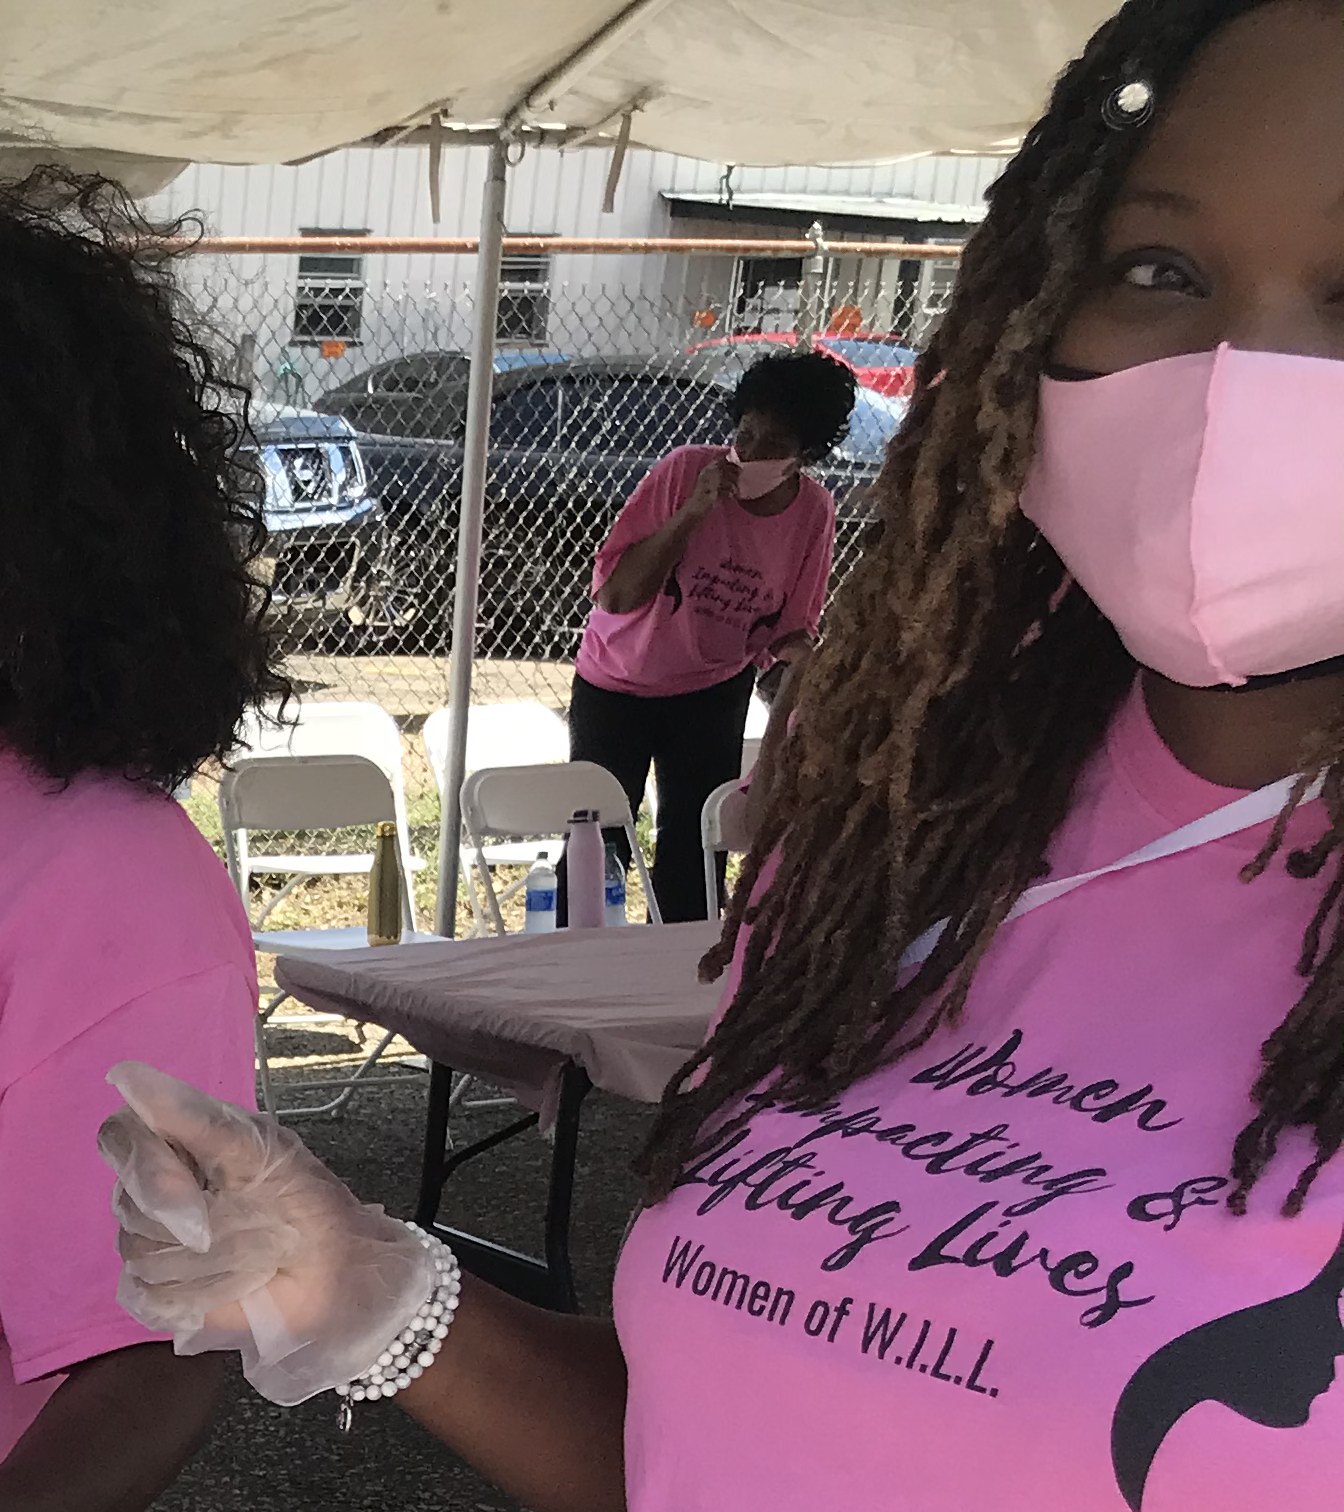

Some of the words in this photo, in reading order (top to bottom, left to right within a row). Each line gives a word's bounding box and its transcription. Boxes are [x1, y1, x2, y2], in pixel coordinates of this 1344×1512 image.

[909, 1028, 1184, 1132] Women
[674, 1127, 911, 1272] Lifting
[907, 1200, 1157, 1330] Lives
[1126, 1175, 1229, 1232] &
[662, 1235, 796, 1327] Women
[803, 1296, 854, 1344] of
[861, 1302, 1000, 1400] W.I.L.L.
